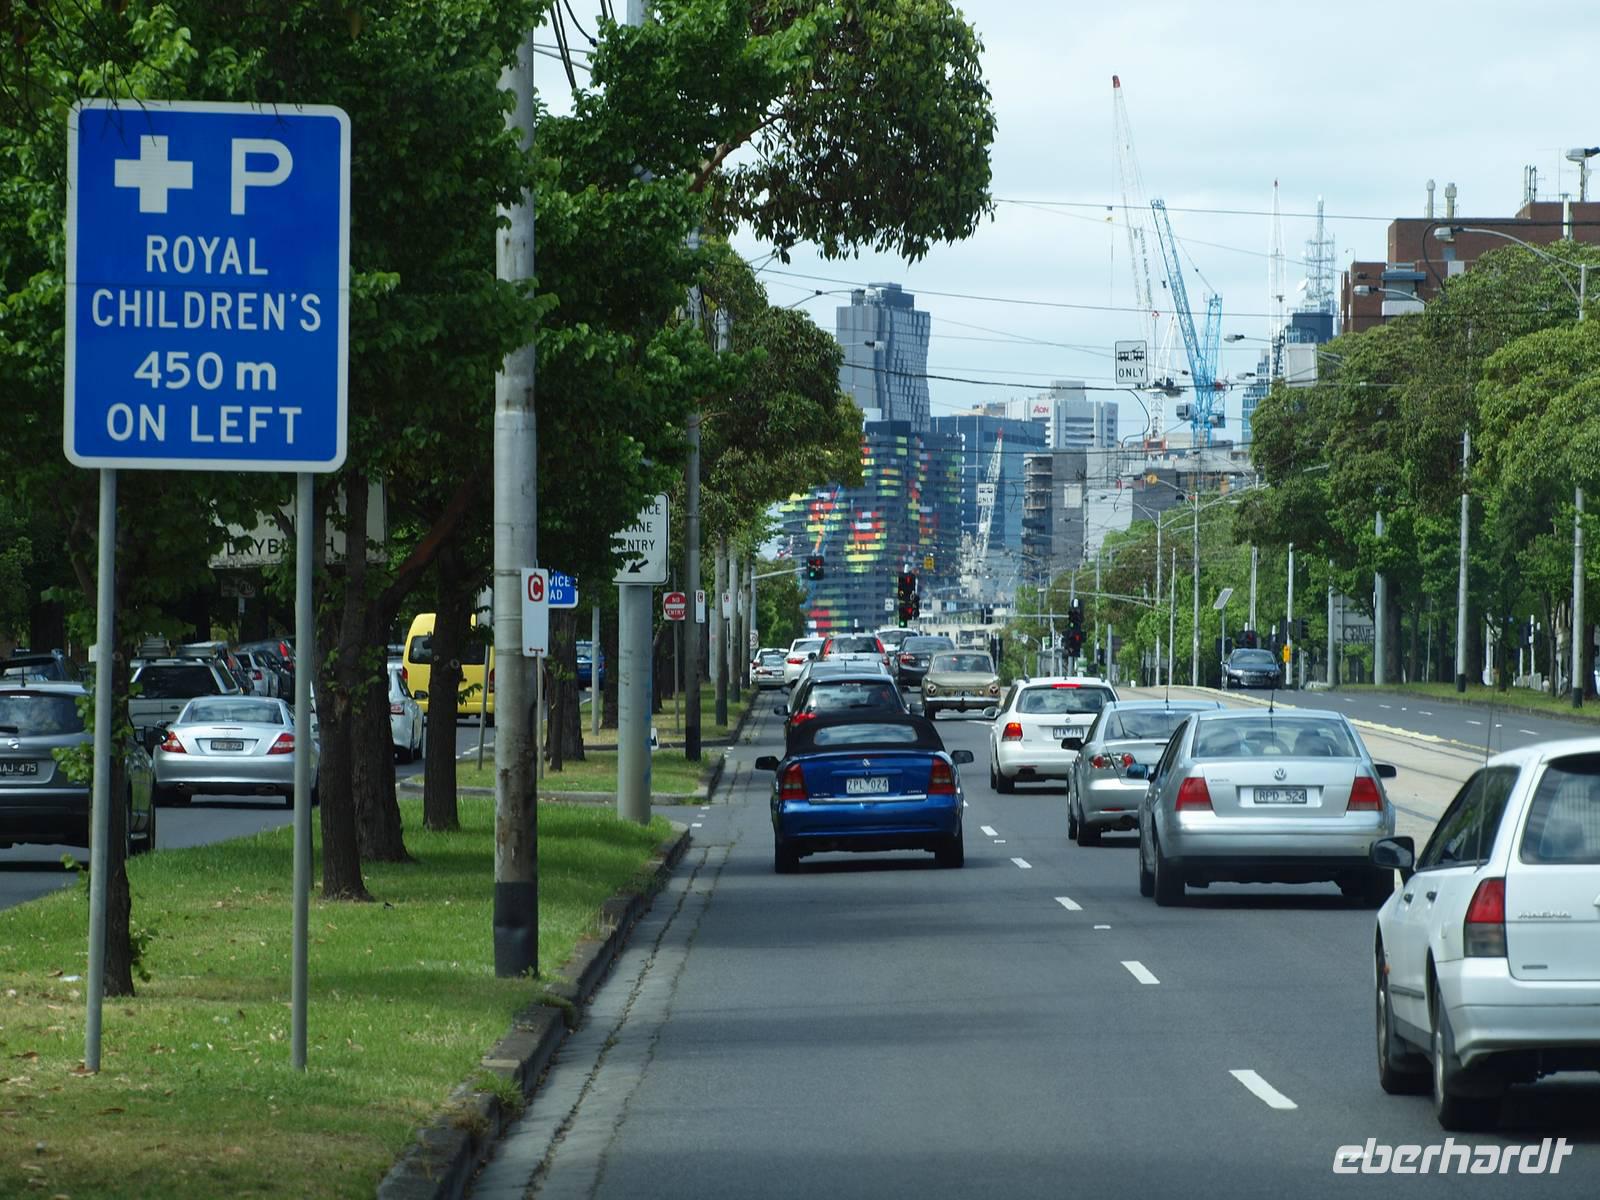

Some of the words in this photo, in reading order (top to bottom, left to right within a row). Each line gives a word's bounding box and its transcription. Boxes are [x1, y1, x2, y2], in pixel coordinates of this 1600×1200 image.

[231, 138, 293, 215] P
[146, 235, 269, 276] ROYAL
[92, 288, 321, 332] CHILDREN'S
[134, 351, 223, 390] 450
[236, 360, 277, 391] m
[1118, 367, 1145, 378] ONLY
[106, 402, 166, 442] ON
[190, 404, 302, 444] LEFT
